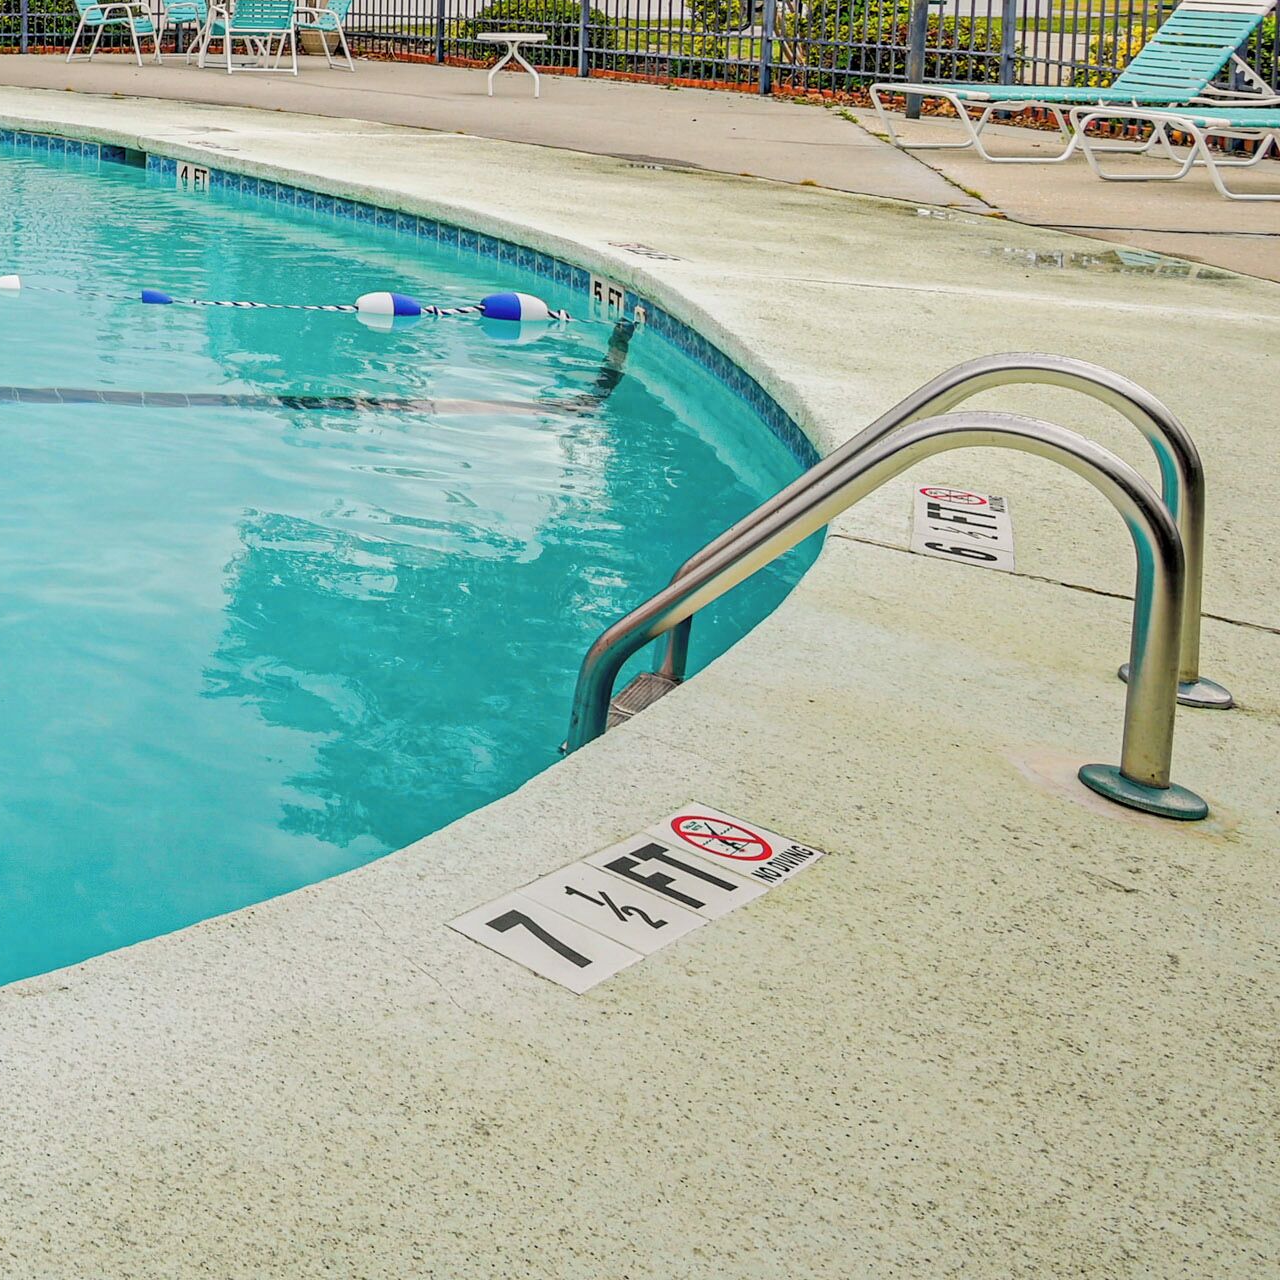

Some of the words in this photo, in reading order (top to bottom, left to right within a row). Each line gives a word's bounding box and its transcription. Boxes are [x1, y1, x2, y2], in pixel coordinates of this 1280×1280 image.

[181, 166, 188, 180] 4
[194, 168, 207, 182] FT
[594, 280, 602, 302] 5
[608, 287, 622, 311] FT
[927, 502, 998, 530] FT
[925, 542, 998, 561] 6
[766, 845, 814, 873] DIVING
[751, 867, 782, 883] NO
[485, 909, 593, 968] 7
[602, 842, 738, 909] FT
